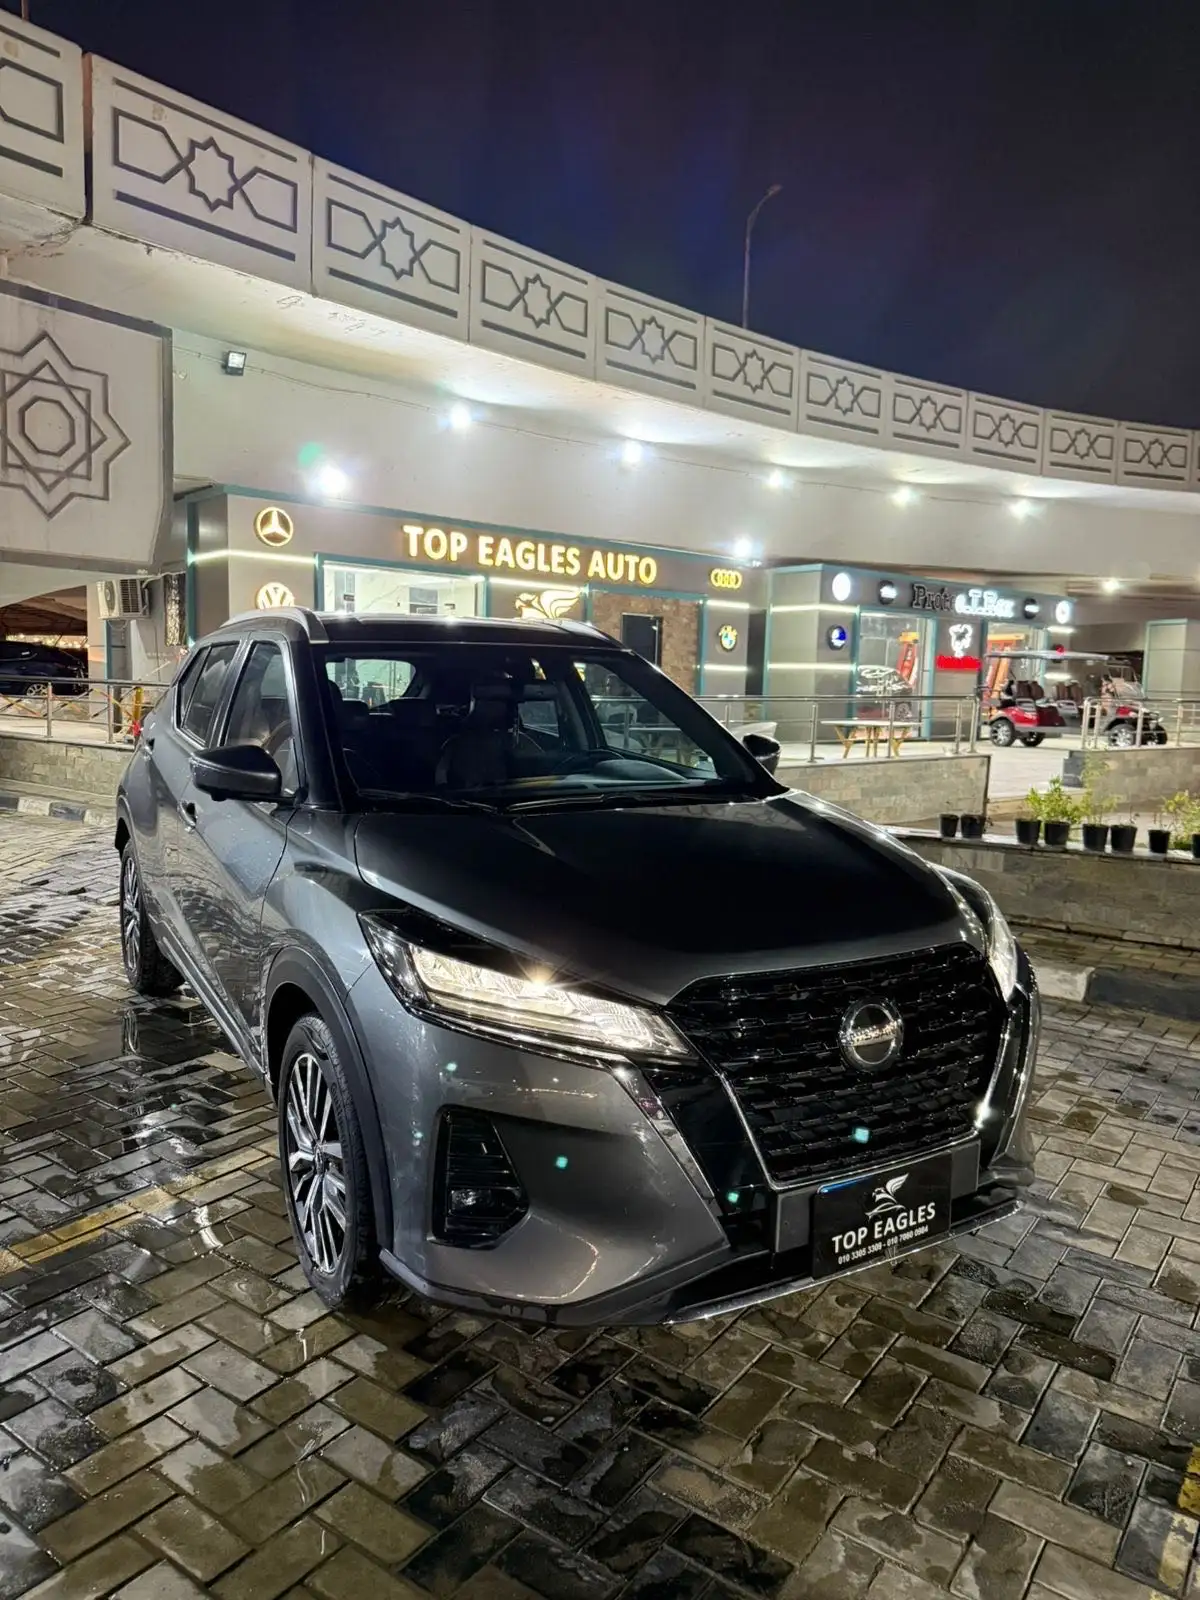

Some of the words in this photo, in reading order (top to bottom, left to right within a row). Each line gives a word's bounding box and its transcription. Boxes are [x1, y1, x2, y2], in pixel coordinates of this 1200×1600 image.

[402, 524, 468, 562] TOP
[477, 534, 581, 577] EAGLES
[587, 549, 658, 585] AUTO
[831, 1226, 868, 1254] TOP
[874, 1202, 936, 1239] EAGLES
[838, 1253, 850, 1265] 010
[886, 1235, 898, 1247] 010
